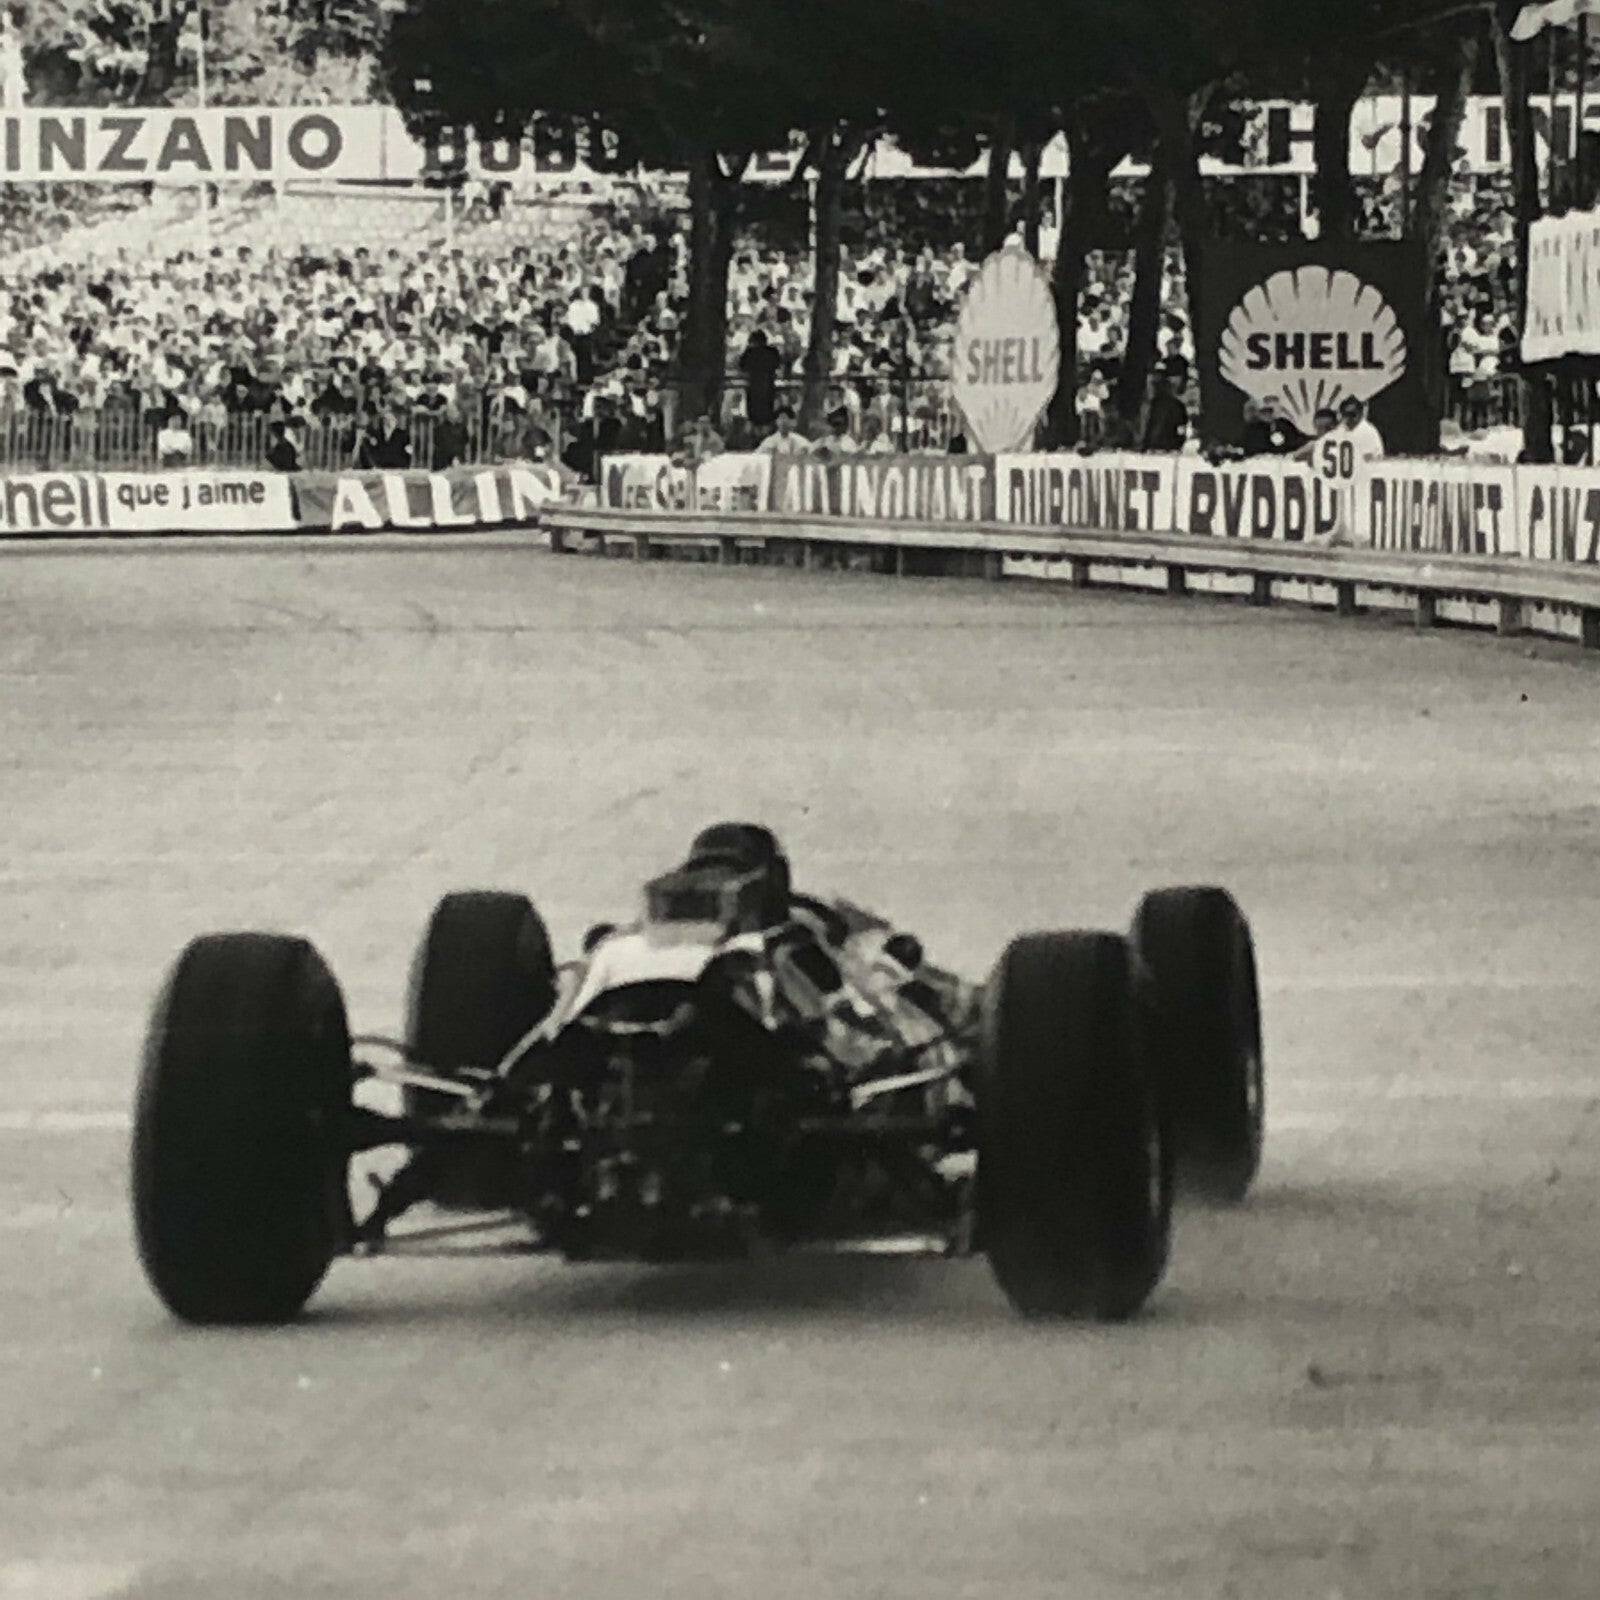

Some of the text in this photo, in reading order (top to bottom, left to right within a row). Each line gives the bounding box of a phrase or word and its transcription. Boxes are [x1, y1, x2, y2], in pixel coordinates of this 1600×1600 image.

[967, 336, 1043, 386] SHELL
[1246, 331, 1385, 370] SHELL
[1322, 439, 1354, 479] 50
[117, 482, 169, 511] que
